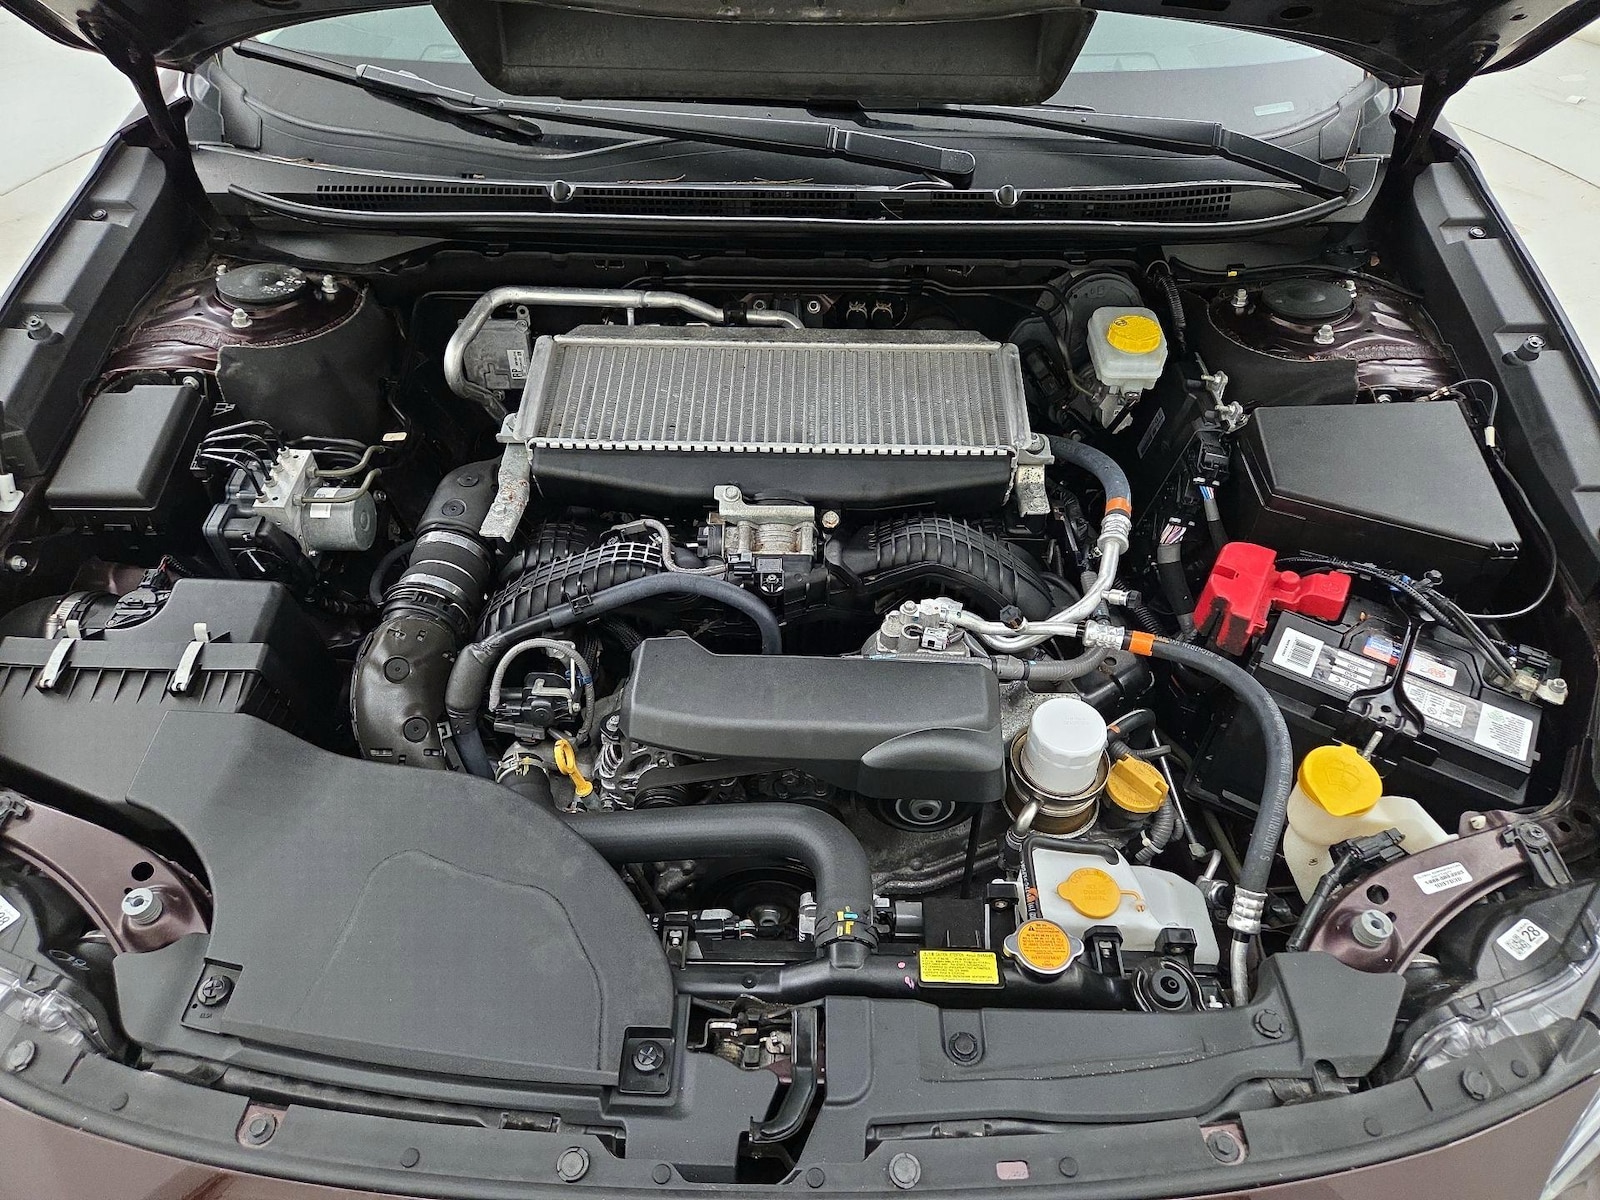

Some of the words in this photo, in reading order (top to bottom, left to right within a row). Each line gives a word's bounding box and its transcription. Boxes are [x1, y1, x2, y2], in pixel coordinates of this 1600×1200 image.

[1263, 815, 1282, 851] NICHIRIN
[1260, 854, 1271, 862] S
[1521, 925, 1541, 942] 28
